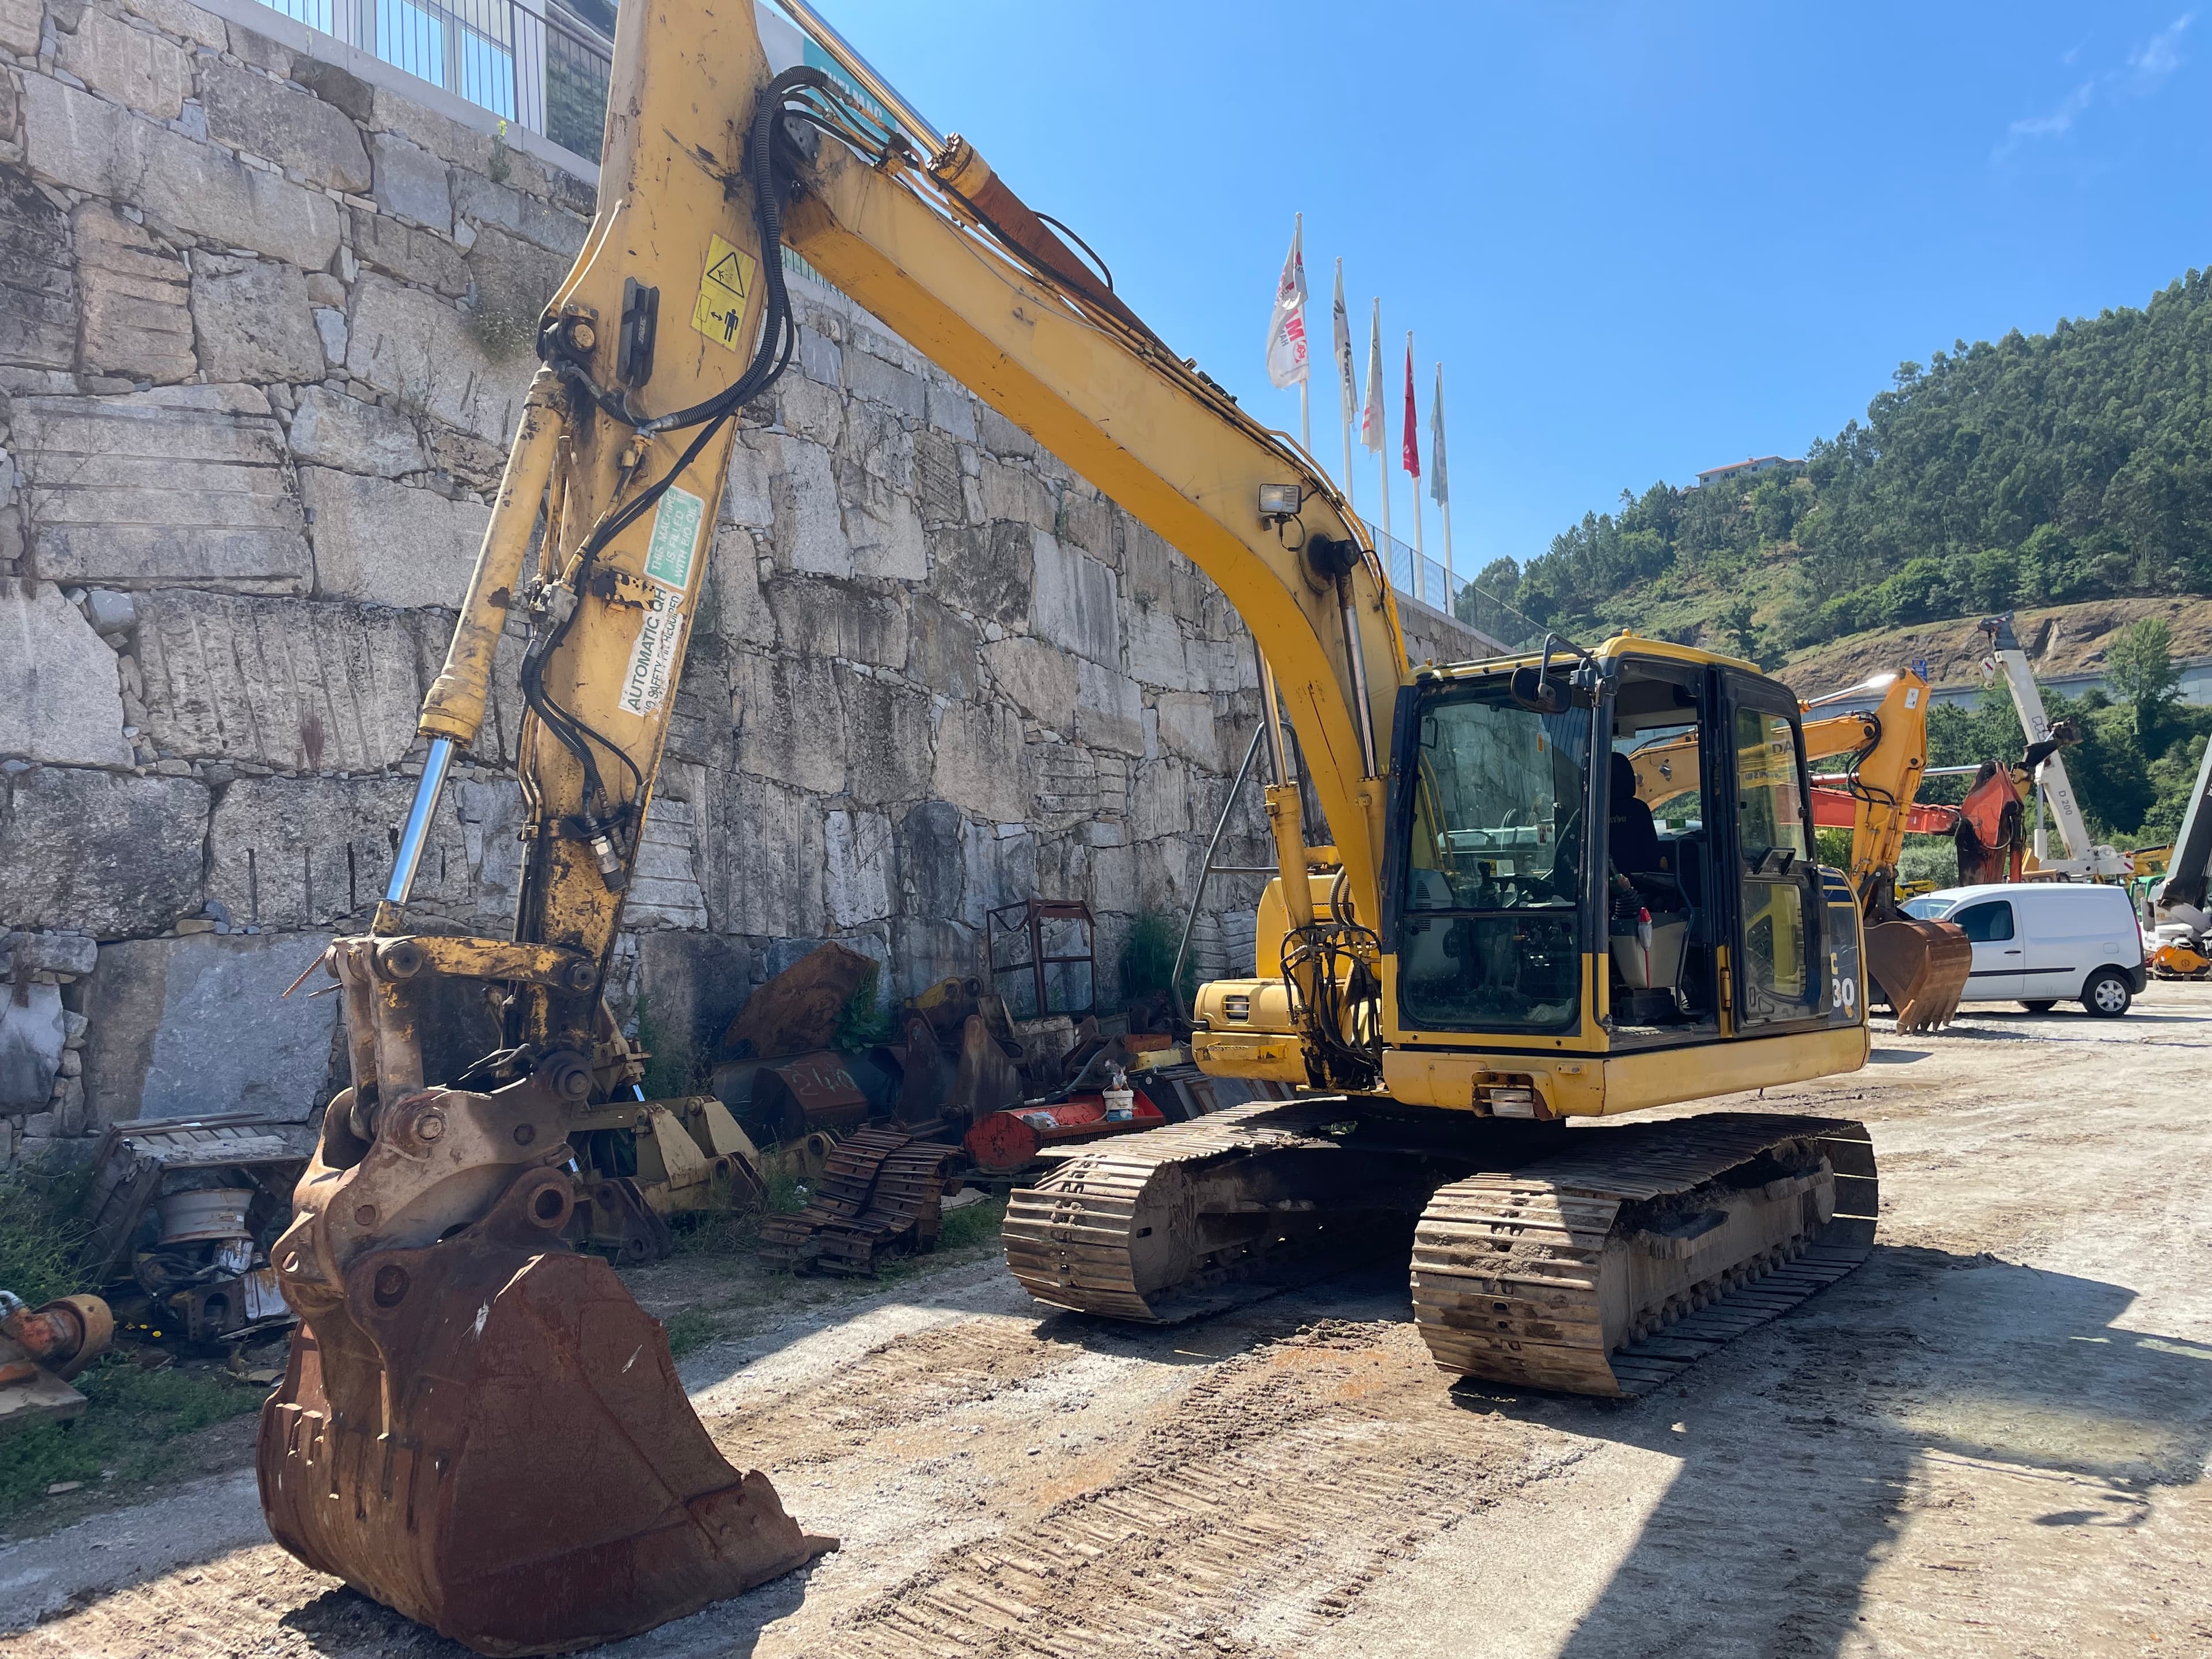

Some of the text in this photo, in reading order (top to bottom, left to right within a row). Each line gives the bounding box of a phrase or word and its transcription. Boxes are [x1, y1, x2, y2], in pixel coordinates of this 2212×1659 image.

[651, 491, 676, 570] THIS MACHINE
[666, 511, 683, 563] IS FILLED
[674, 506, 697, 577] WITH BIO OIL
[628, 588, 666, 710] AUTOMATIC QH
[2062, 800, 2073, 815] 200
